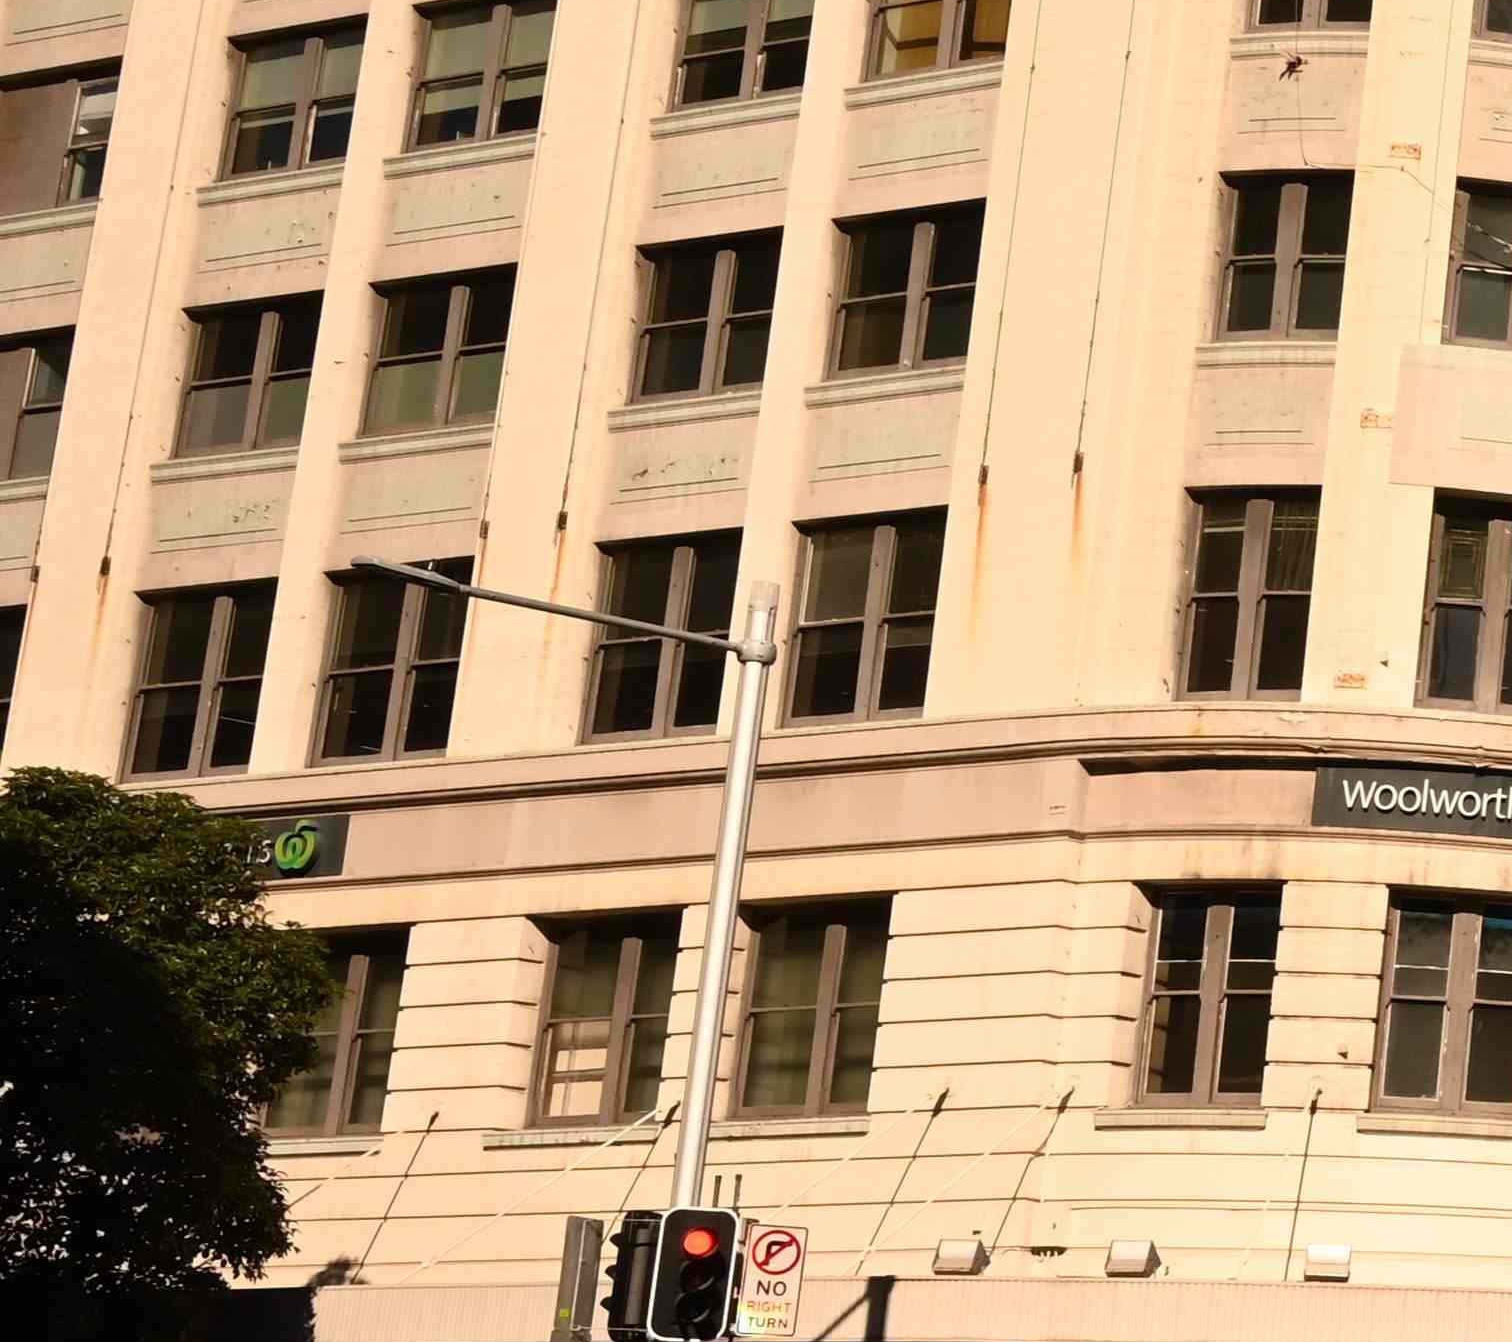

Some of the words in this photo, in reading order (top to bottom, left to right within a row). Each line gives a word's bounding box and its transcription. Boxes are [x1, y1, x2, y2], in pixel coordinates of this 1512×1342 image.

[755, 1280, 787, 1297] NO
[746, 1300, 792, 1313] RIGHT
[747, 1316, 789, 1329] TURN
